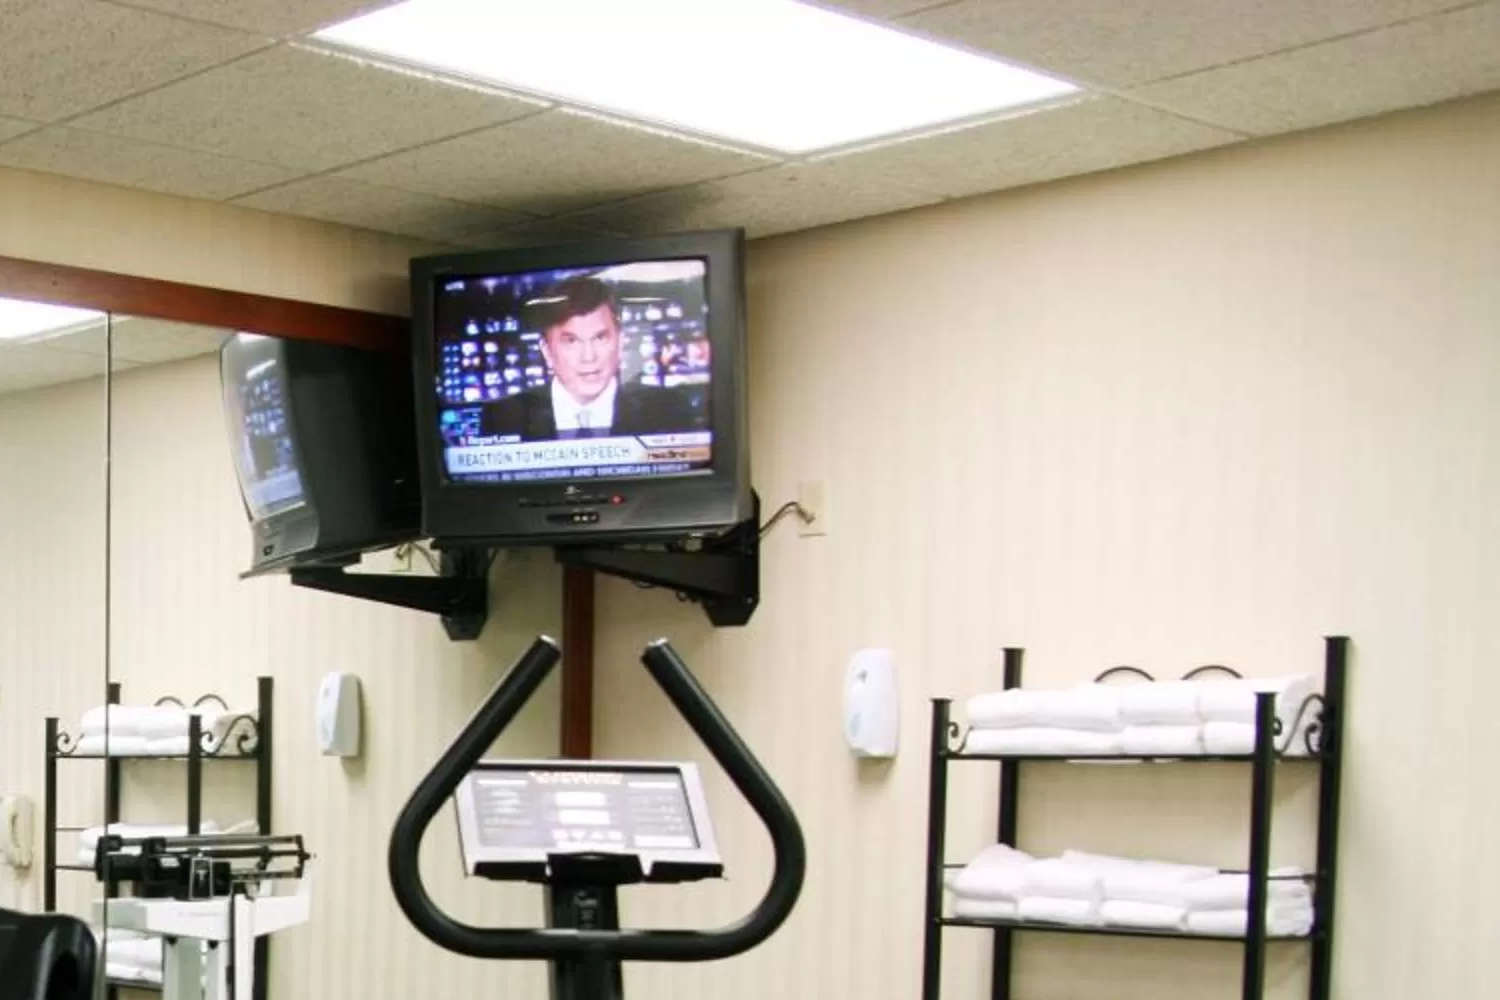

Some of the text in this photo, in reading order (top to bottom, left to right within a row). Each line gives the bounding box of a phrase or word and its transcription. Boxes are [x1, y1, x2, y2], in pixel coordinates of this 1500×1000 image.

[458, 451, 513, 466] REACTION
[515, 450, 531, 463] TO
[581, 445, 629, 459] SPEECH
